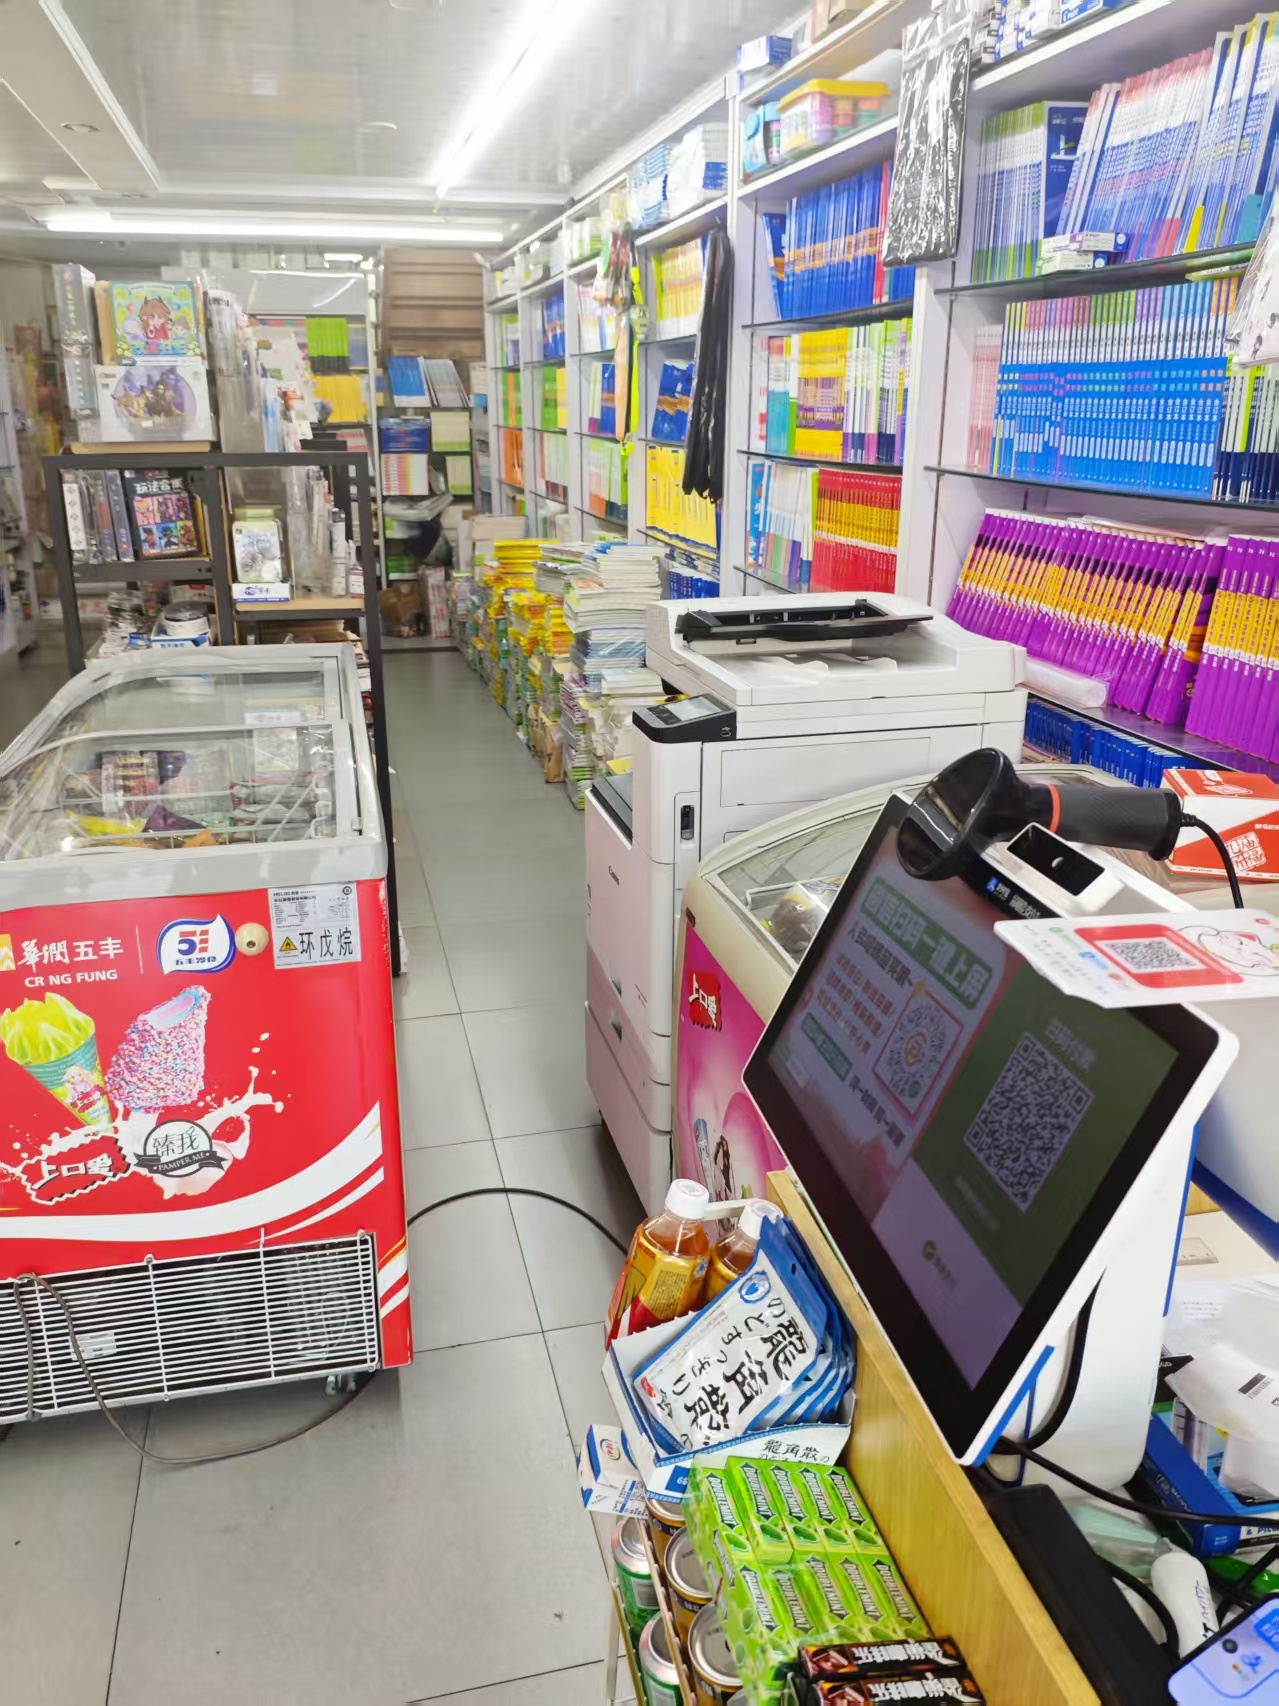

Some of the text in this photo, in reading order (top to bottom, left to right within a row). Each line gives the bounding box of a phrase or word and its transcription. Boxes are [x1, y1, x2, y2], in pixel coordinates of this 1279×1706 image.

[299, 927, 353, 960] 环戊烷
[24, 969, 118, 988] CR NG FUNG
[158, 1152, 206, 1171] PAMPER ME
